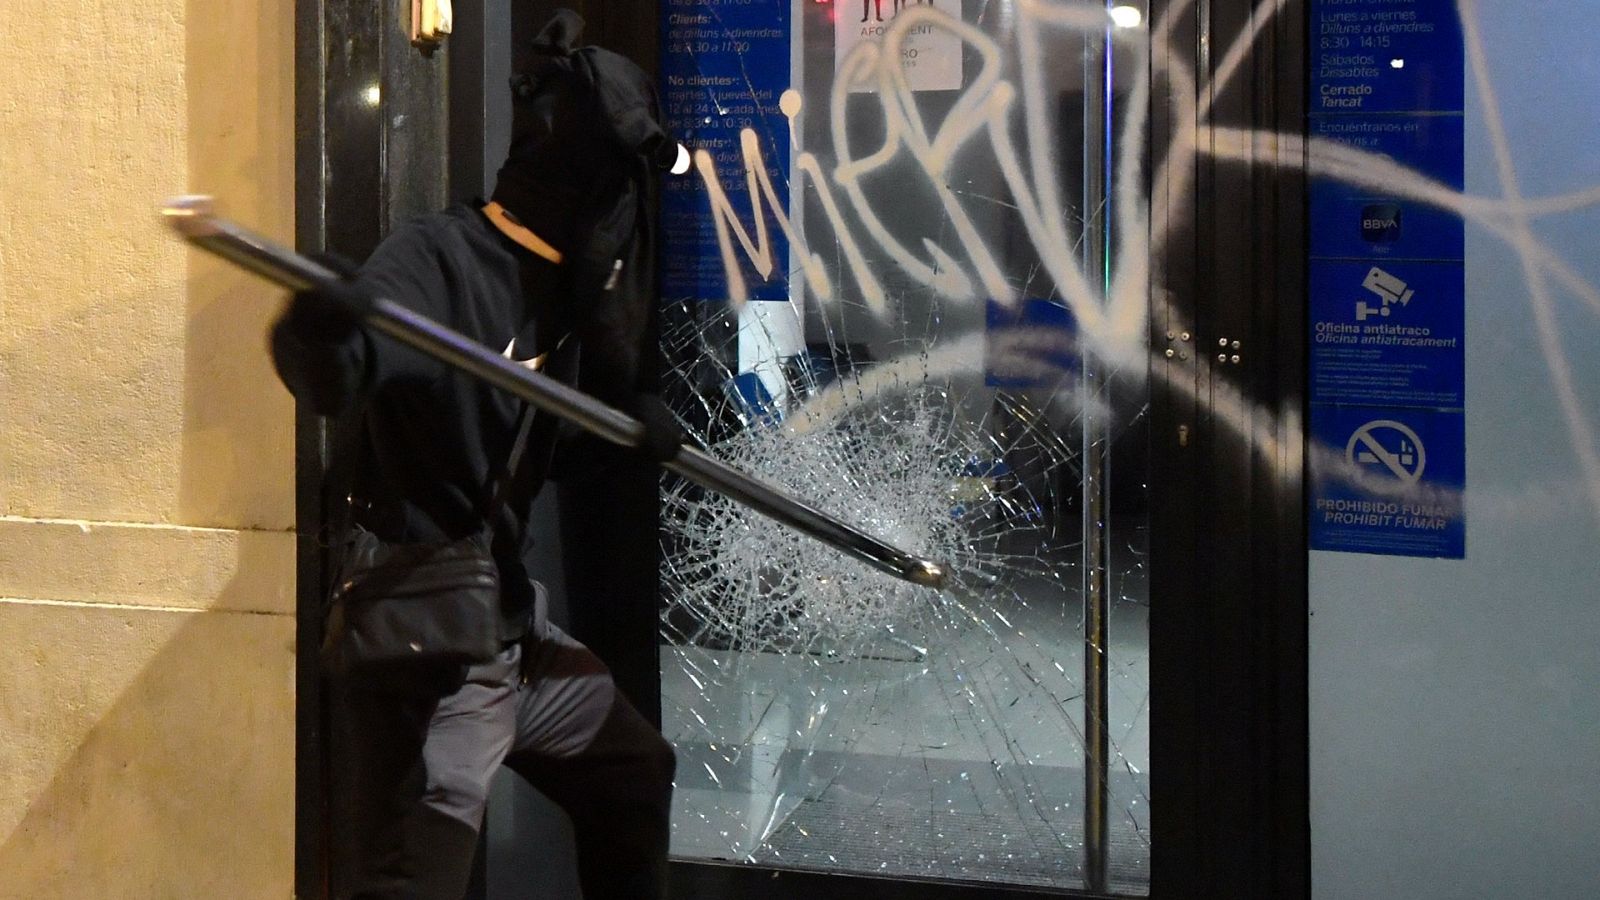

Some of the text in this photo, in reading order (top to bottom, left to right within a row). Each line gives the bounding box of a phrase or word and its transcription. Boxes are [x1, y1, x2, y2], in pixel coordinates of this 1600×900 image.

[668, 14, 712, 25] Clients:
[1320, 10, 1417, 22] Lunes a viernes
[860, 25, 933, 35] AFOENT
[1320, 21, 1434, 34] Dilluns a divendres
[1320, 36, 1391, 49] 8:30 14:15
[1320, 66, 1380, 78] Dissabtes
[668, 75, 684, 86] No
[1320, 84, 1373, 96] Cerrado
[1321, 96, 1363, 108] Tancat
[694, 103, 709, 114] 24
[1362, 218, 1399, 230] BBVA
[1315, 321, 1430, 336] Oficina antiatraco
[1315, 332, 1457, 347] Oficina antiatracament
[1316, 499, 1398, 514] PROHIBIDO
[1324, 511, 1447, 530] PROHIBIT FUMAR
